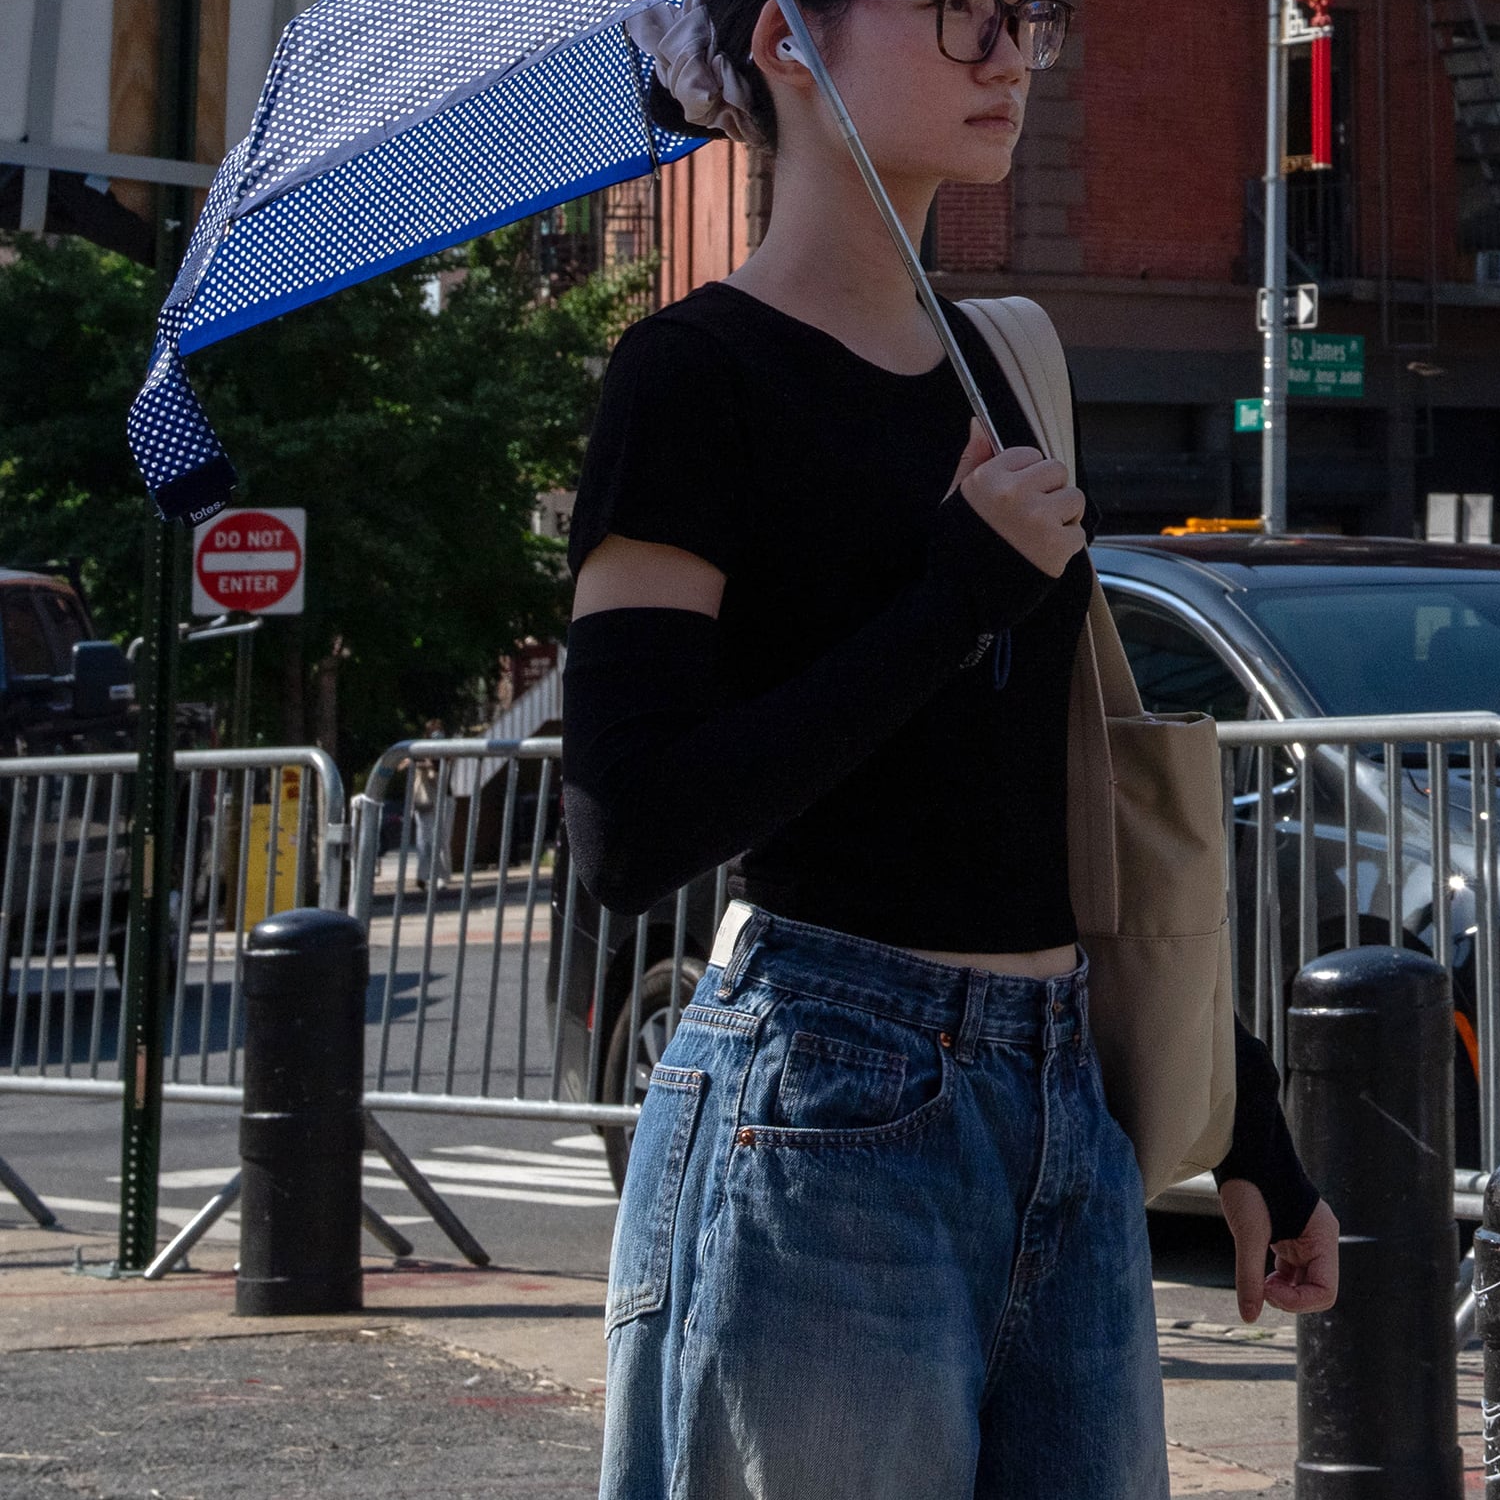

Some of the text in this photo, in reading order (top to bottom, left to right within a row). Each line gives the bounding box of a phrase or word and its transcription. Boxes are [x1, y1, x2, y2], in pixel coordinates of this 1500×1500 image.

[1291, 337, 1304, 360] St
[1309, 338, 1346, 362] James
[215, 530, 284, 548] DO NOT
[218, 575, 278, 594] ENTER
